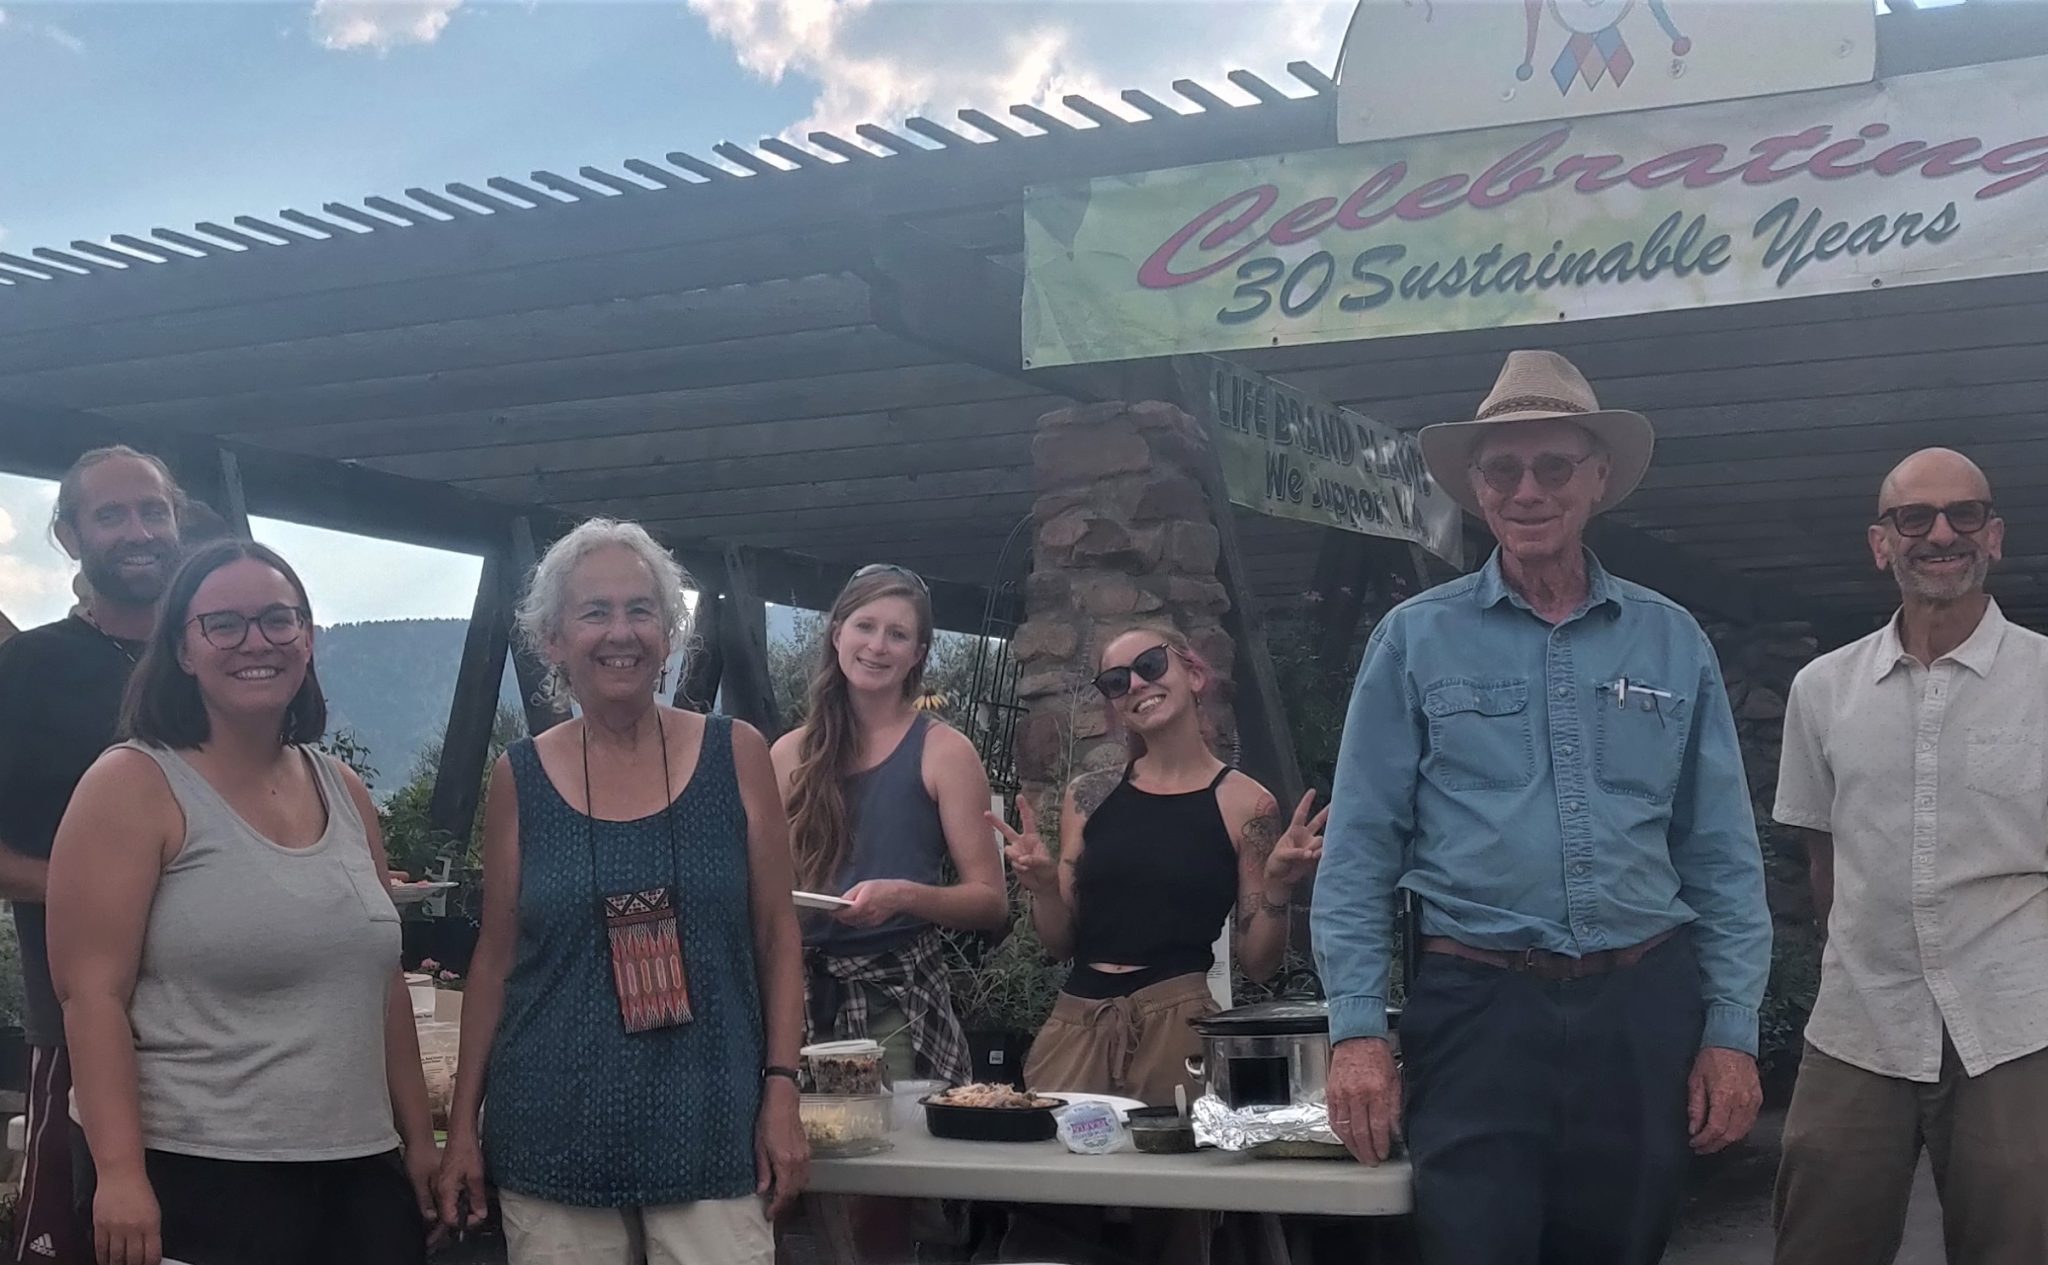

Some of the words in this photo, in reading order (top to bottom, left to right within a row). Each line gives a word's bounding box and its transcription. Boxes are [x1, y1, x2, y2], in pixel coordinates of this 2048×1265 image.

[1137, 123, 2048, 289] Celebrating
[1216, 250, 1336, 325] 30
[1338, 210, 1731, 312] Sustainable
[1752, 198, 1960, 288] Years
[1216, 370, 1268, 439] LIFE
[1273, 391, 1354, 467] BRAND
[1266, 450, 1304, 503] We
